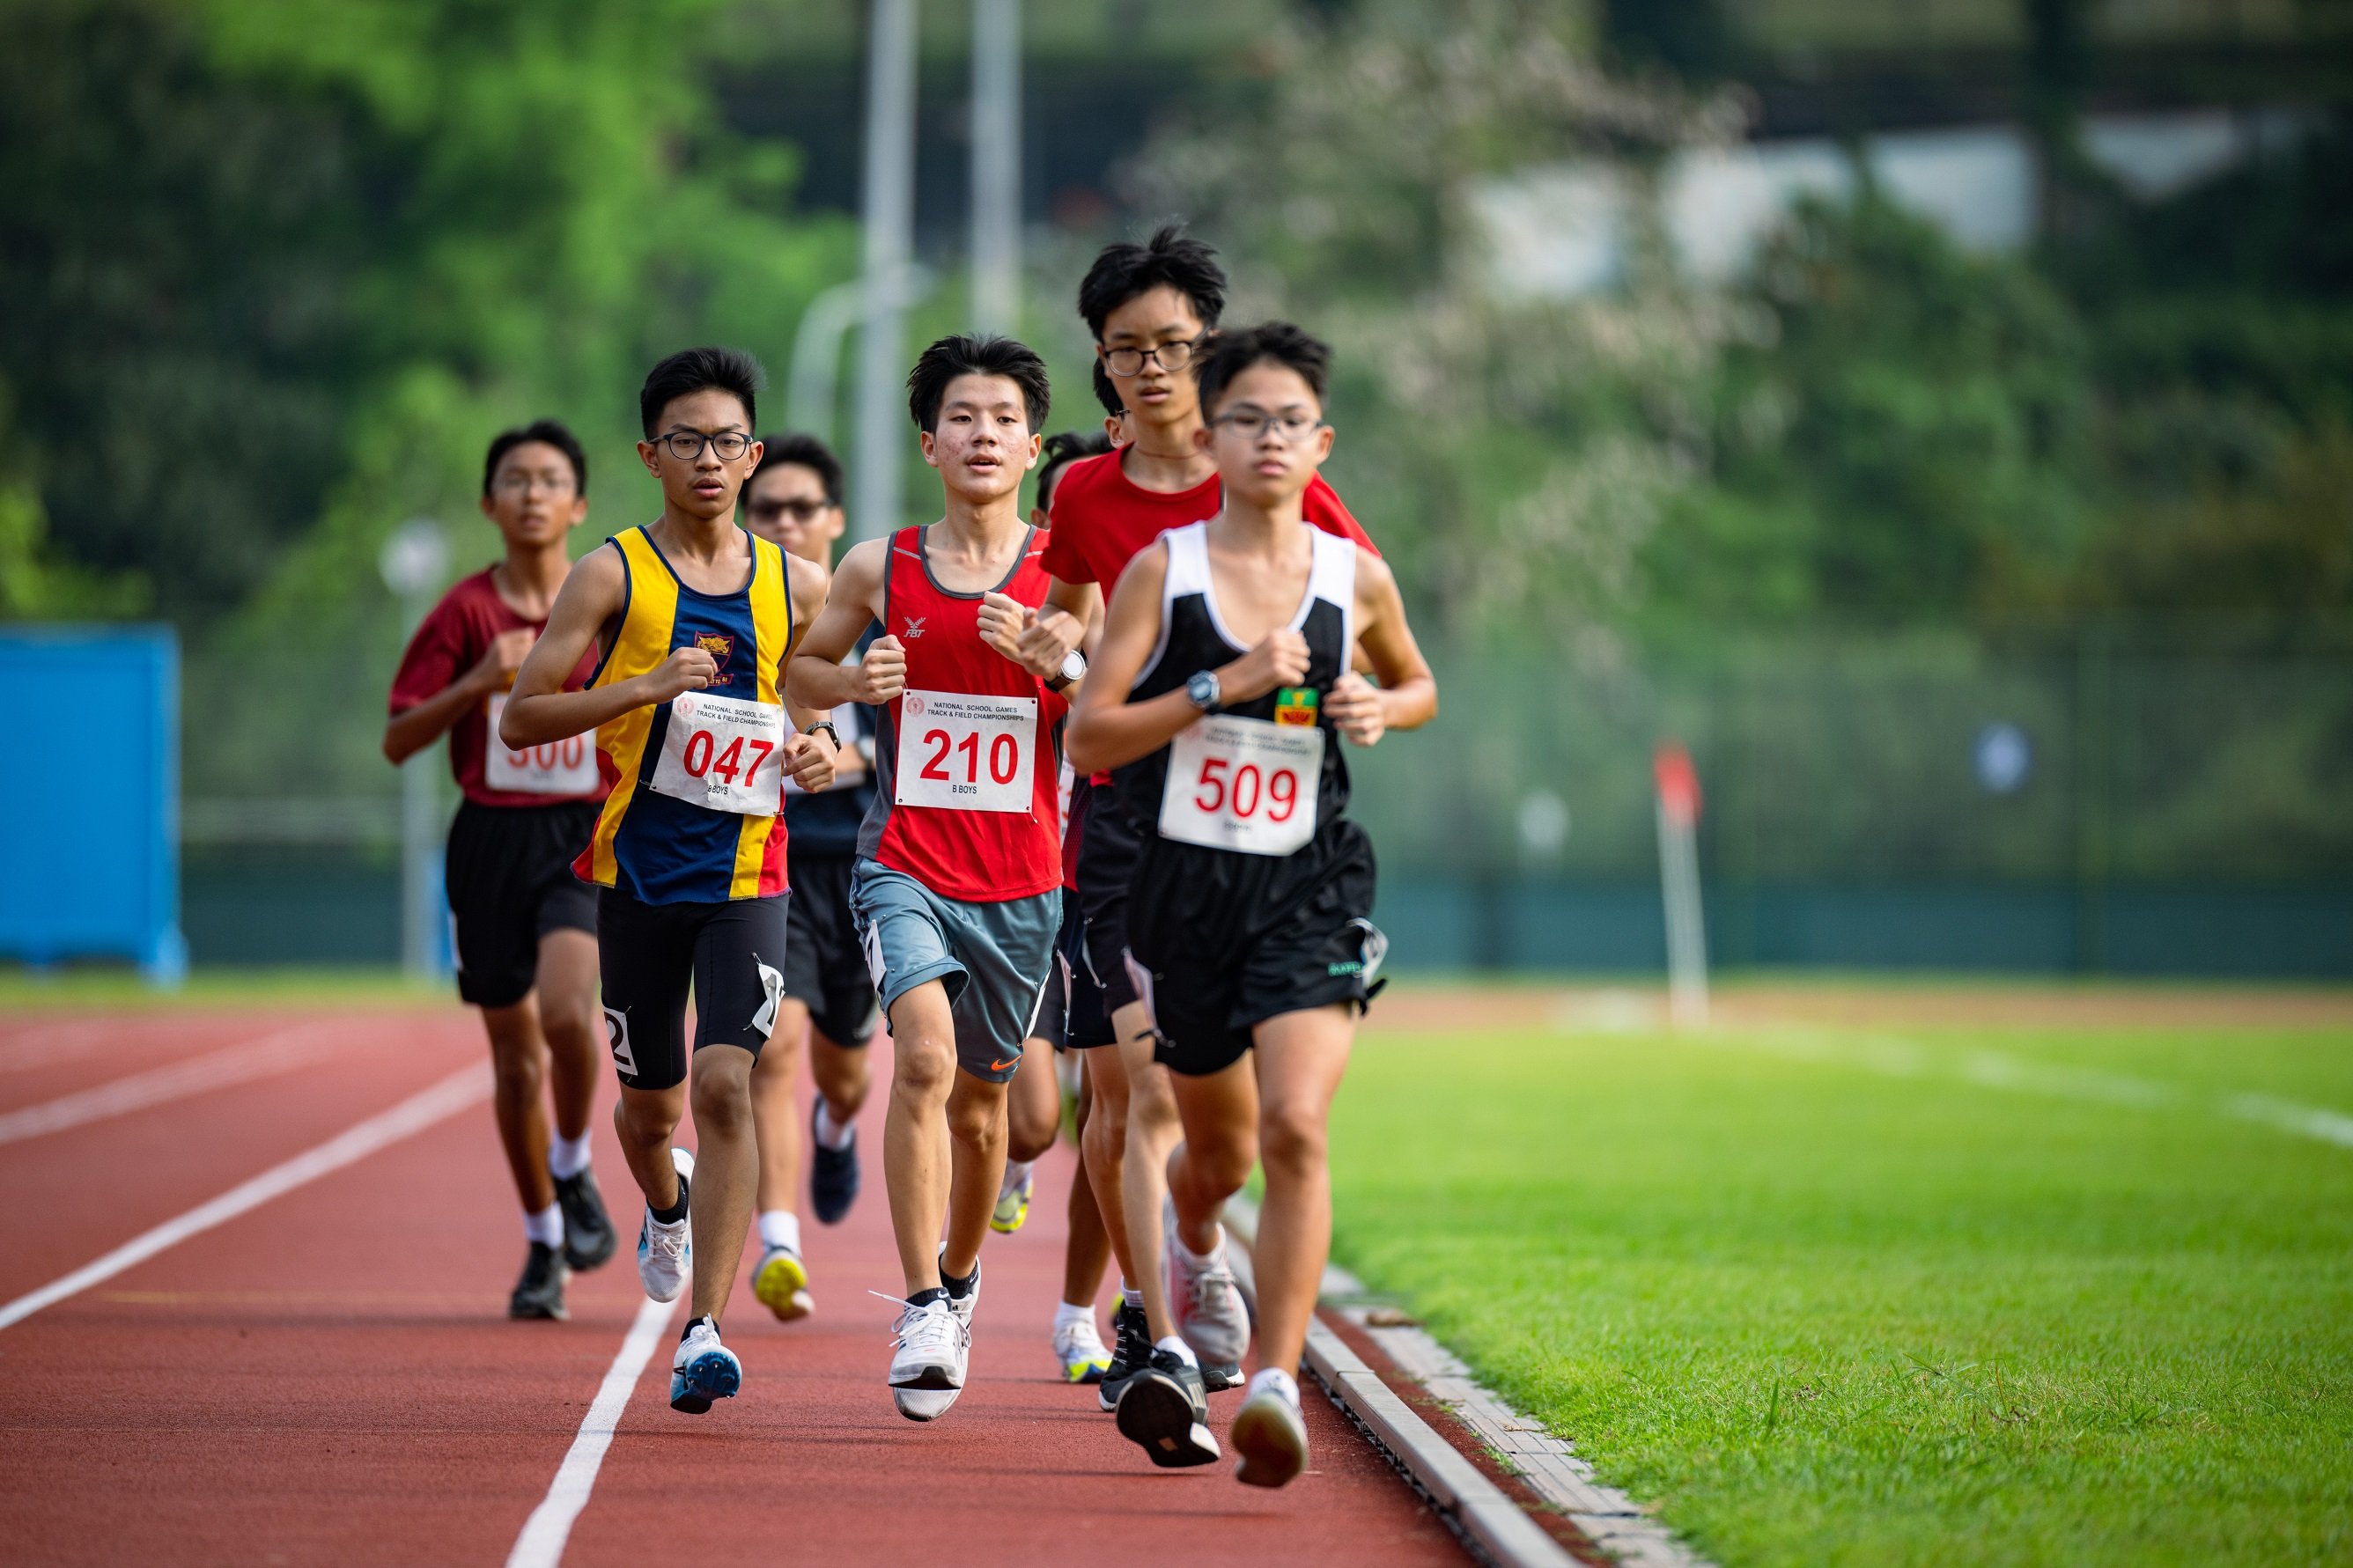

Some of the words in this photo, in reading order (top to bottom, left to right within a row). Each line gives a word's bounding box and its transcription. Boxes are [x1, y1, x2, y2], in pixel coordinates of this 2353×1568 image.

[703, 703, 732, 714] NATIONAL
[734, 709, 757, 718] SCHOOL
[933, 702, 963, 710] NATIONAL
[697, 710, 716, 718] TRACK
[927, 709, 948, 718] TRACK
[955, 710, 972, 719] FIELD
[973, 712, 1024, 722] CHAMPIONSHIPS
[683, 730, 774, 788] 047
[919, 728, 1019, 785] 210
[712, 784, 728, 795] BOYS
[952, 784, 957, 793] B
[958, 784, 977, 794] BOYS
[1195, 758, 1297, 822] 509
